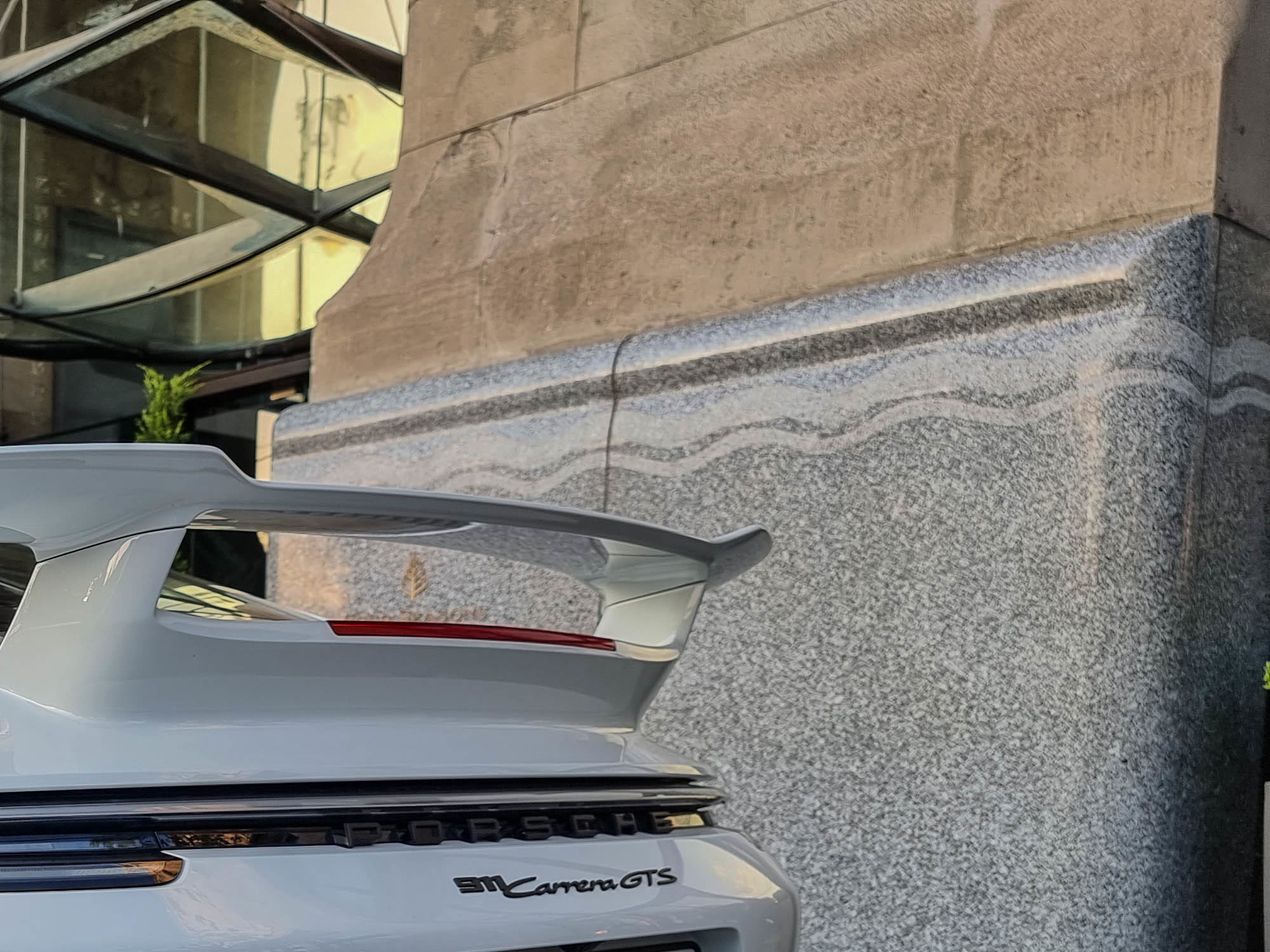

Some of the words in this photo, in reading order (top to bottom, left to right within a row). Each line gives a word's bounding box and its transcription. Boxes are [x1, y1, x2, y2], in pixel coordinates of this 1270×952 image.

[341, 811, 675, 847] PORSCHE
[453, 874, 507, 893] 911
[504, 875, 619, 898] Carrera
[620, 868, 677, 890] GTS
